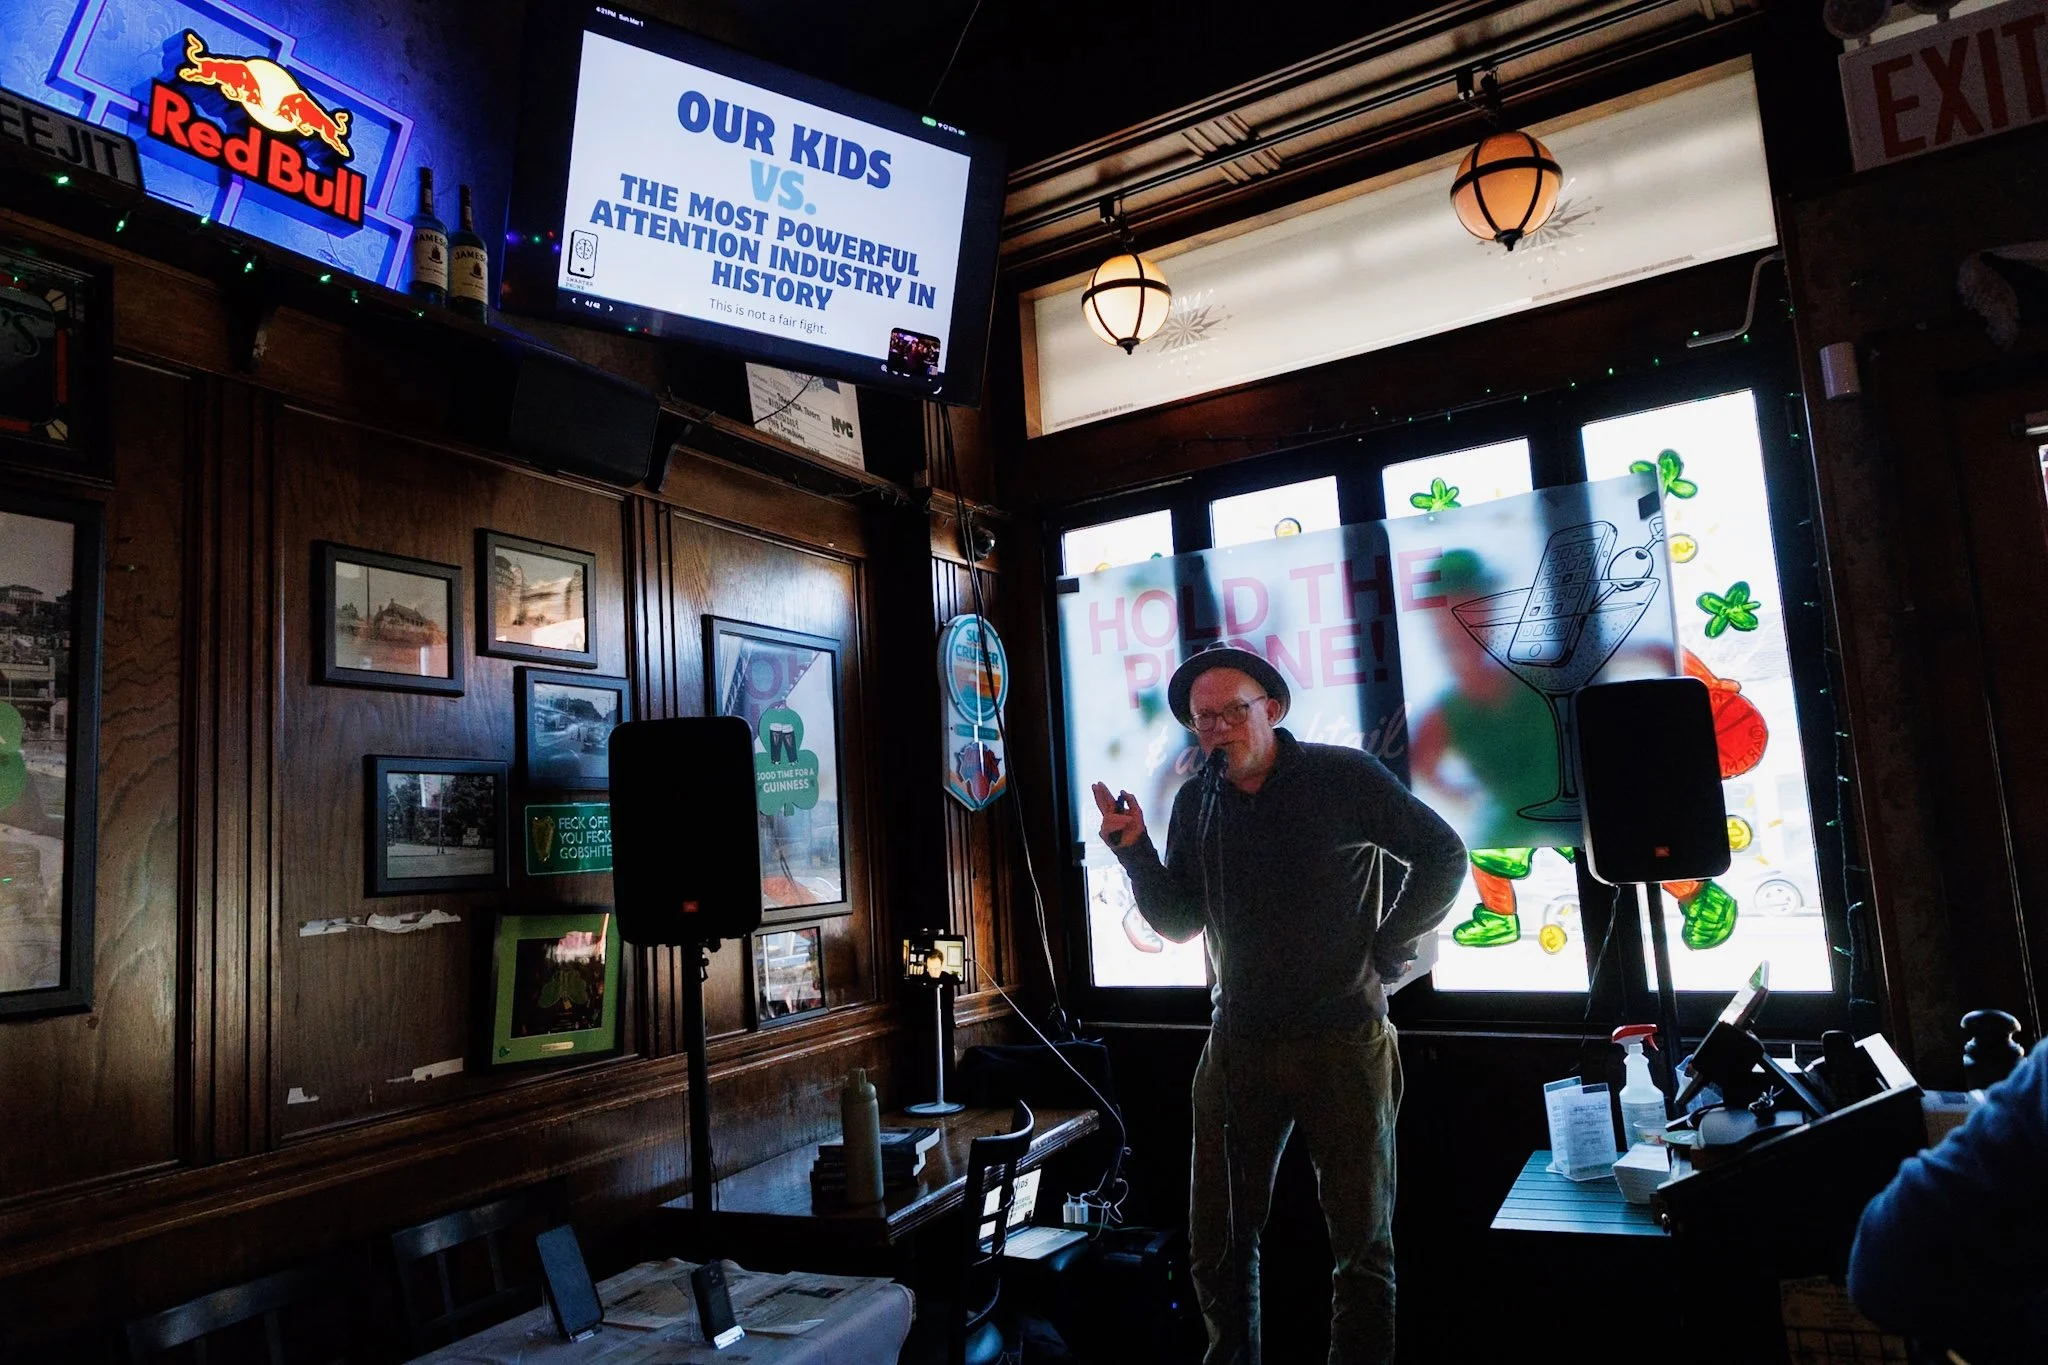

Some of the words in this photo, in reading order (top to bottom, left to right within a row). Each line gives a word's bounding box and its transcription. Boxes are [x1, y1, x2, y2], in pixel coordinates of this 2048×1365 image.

[1871, 12, 2047, 159] EXIT
[151, 84, 262, 178] Red
[267, 139, 362, 222] Bull
[677, 90, 775, 156] OUR
[789, 123, 892, 189] KIDS
[750, 159, 817, 216] VS.
[620, 173, 679, 213] THE
[688, 191, 769, 236] MOST
[776, 216, 920, 277] POWERFUL
[589, 199, 761, 265] ATTENTION
[768, 244, 902, 300] INDUSTRY
[908, 281, 937, 310] IN
[711, 260, 834, 312] HISTORY
[709, 298, 733, 313] This
[735, 303, 745, 316] is
[747, 307, 767, 321] not
[769, 313, 776, 323] a
[778, 313, 798, 328] fair
[800, 318, 828, 336] fight.
[831, 415, 854, 439] NYC
[1088, 576, 1270, 656] HOLD
[1289, 547, 1448, 626] THE
[763, 778, 810, 793] GUINNESS
[777, 769, 794, 779] TIME
[795, 767, 809, 778] FOR
[809, 767, 815, 776] A
[558, 816, 586, 830] FECK
[588, 815, 609, 829] OFF
[559, 831, 584, 845] YOU
[559, 843, 613, 860] GOBSHITE
